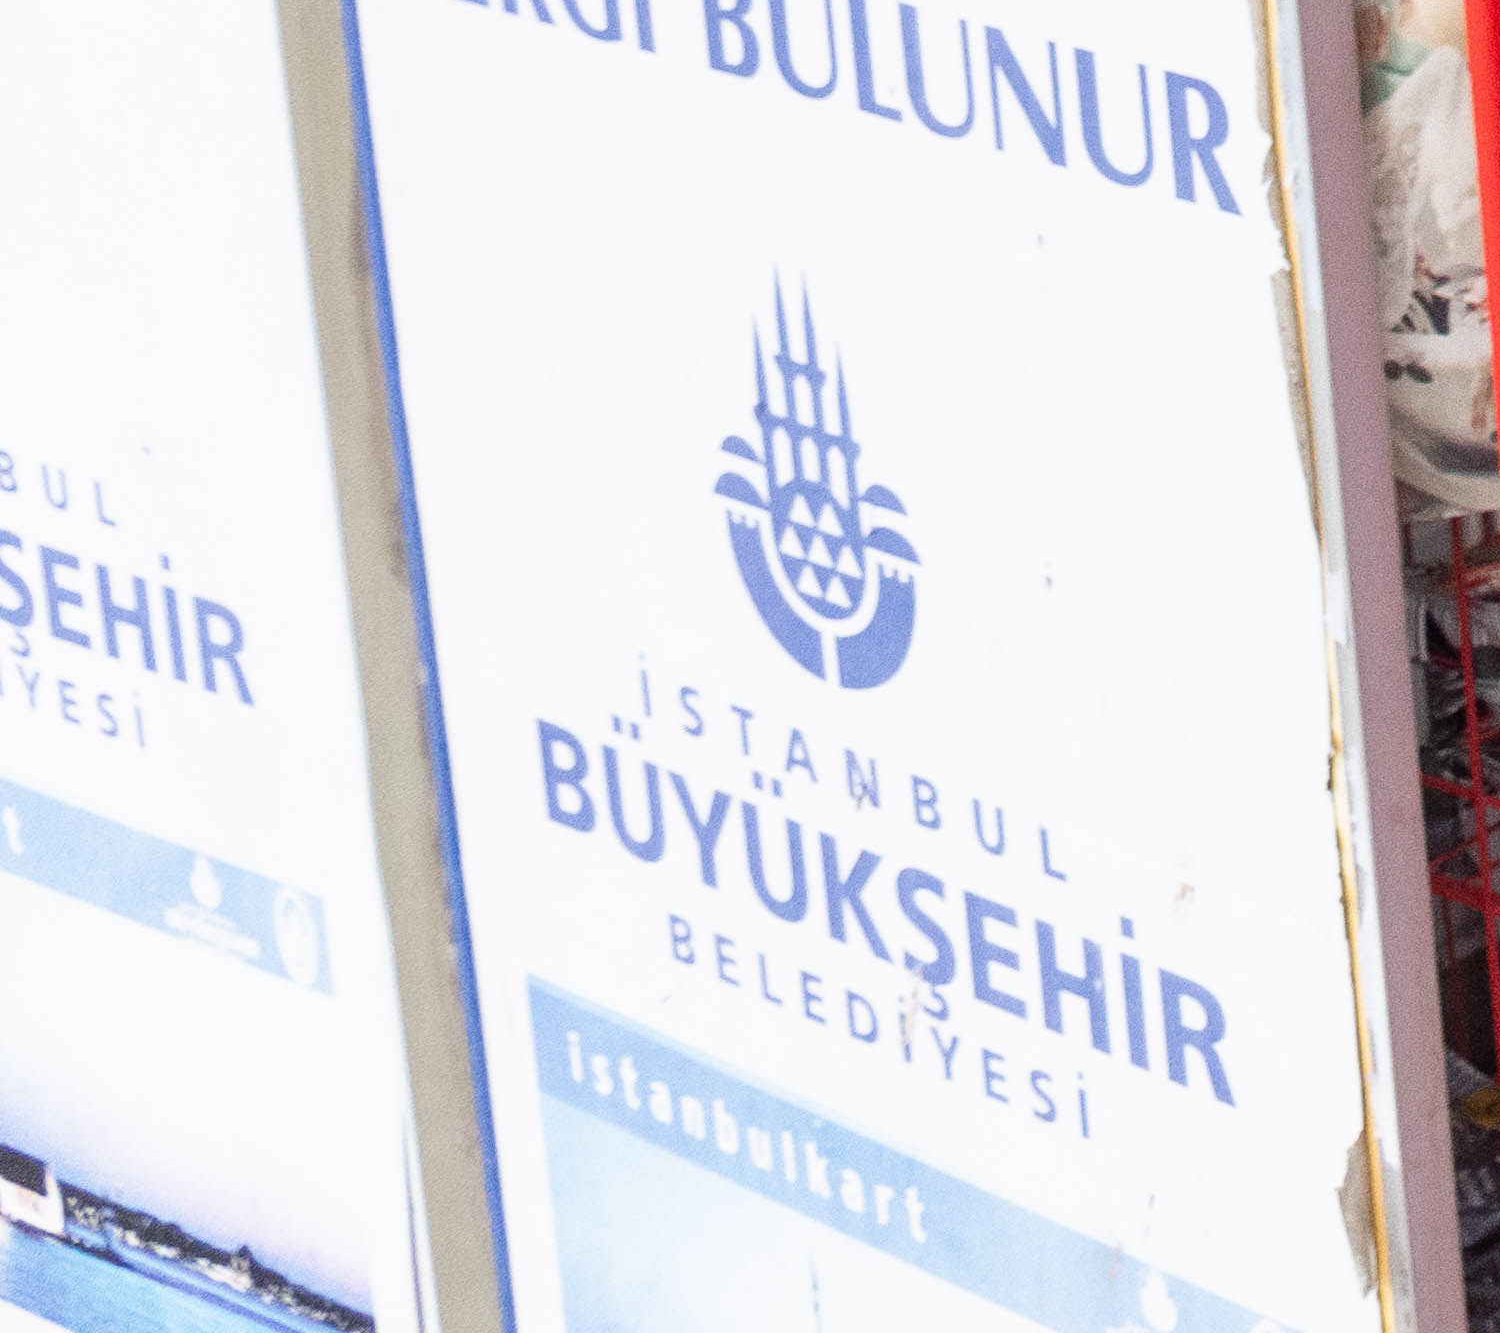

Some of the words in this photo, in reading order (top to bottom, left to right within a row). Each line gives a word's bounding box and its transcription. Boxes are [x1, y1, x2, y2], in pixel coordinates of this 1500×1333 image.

[636, 651, 1074, 883] İSTANBUL
[536, 716, 1239, 1109] BÜYÜKŞEHİR
[667, 913, 1095, 1140] BELEDİYESİ
[565, 1029, 931, 1245] istanbulkart
